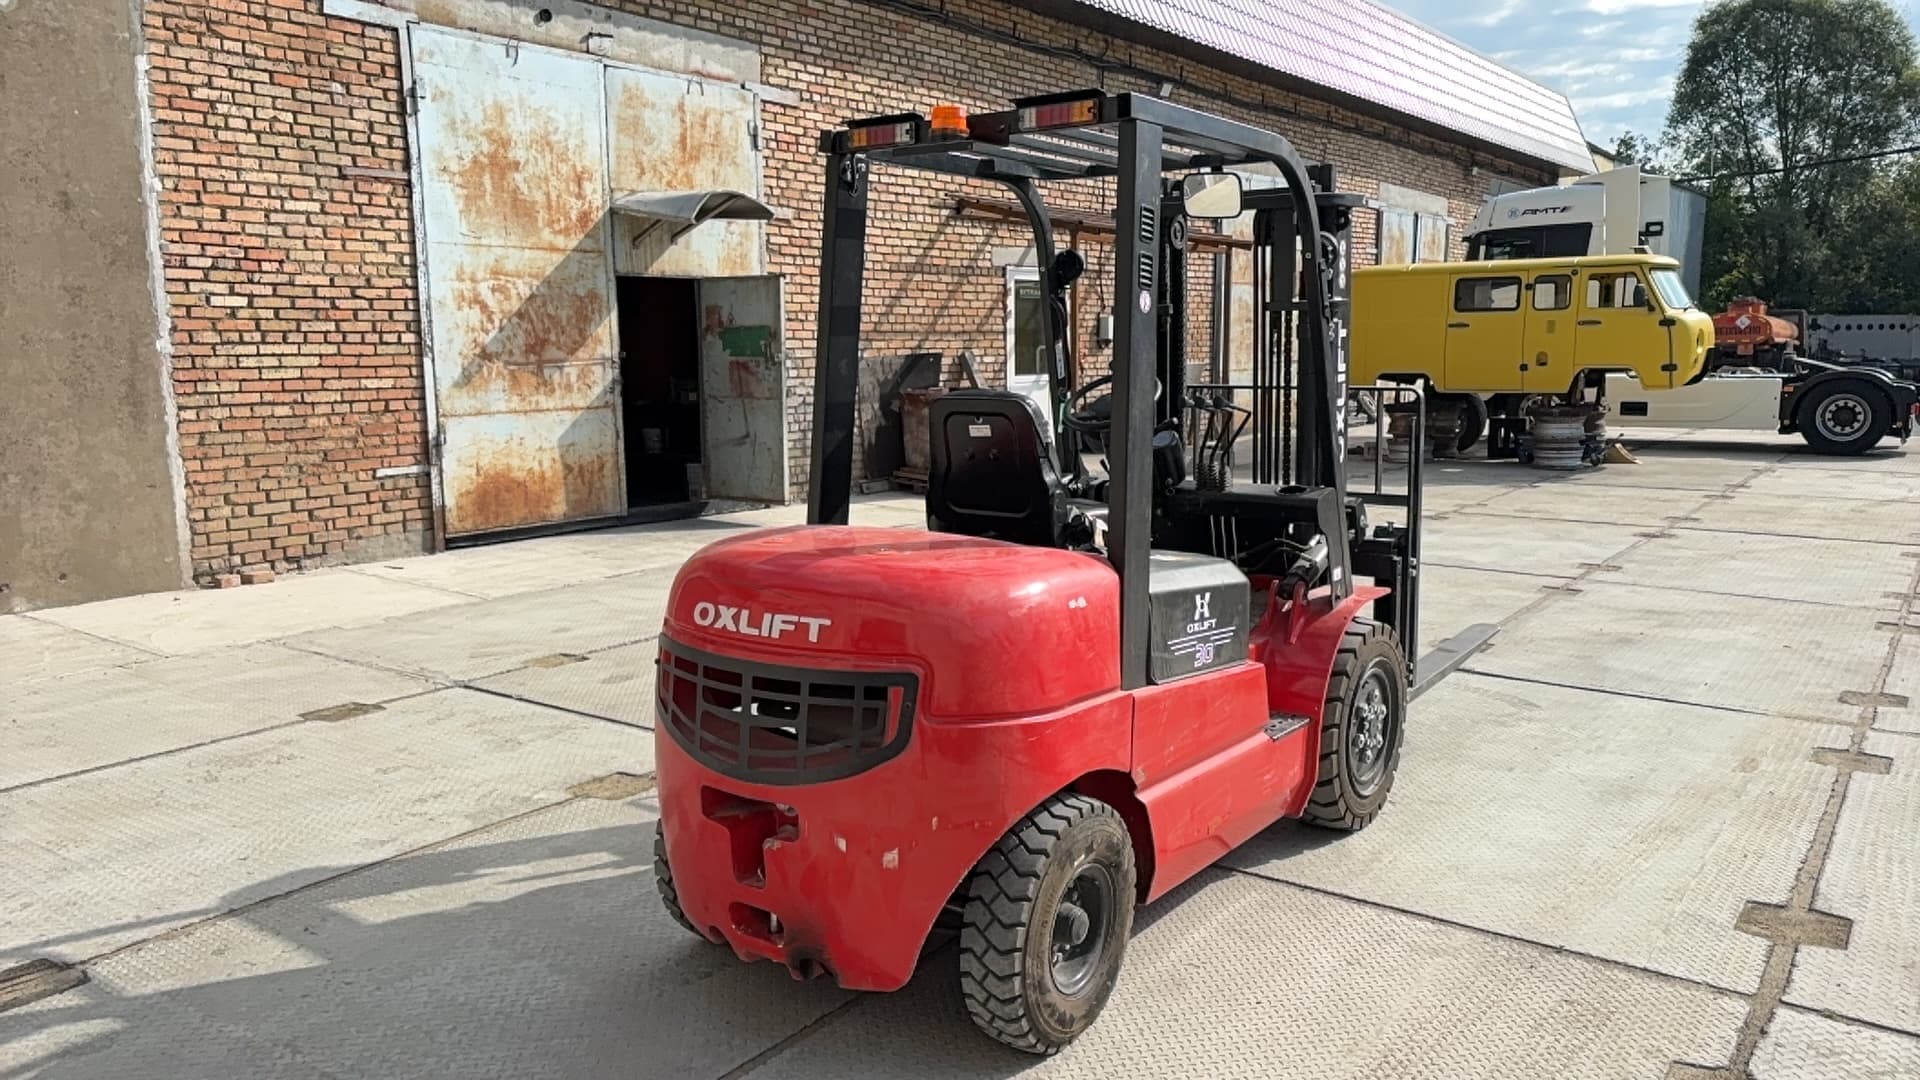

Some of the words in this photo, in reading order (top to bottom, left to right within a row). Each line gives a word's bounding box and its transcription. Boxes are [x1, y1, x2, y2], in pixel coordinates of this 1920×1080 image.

[693, 601, 832, 643] OXLIFT
[1186, 618, 1217, 634] OXLIFT
[1194, 643, 1214, 668] 30
